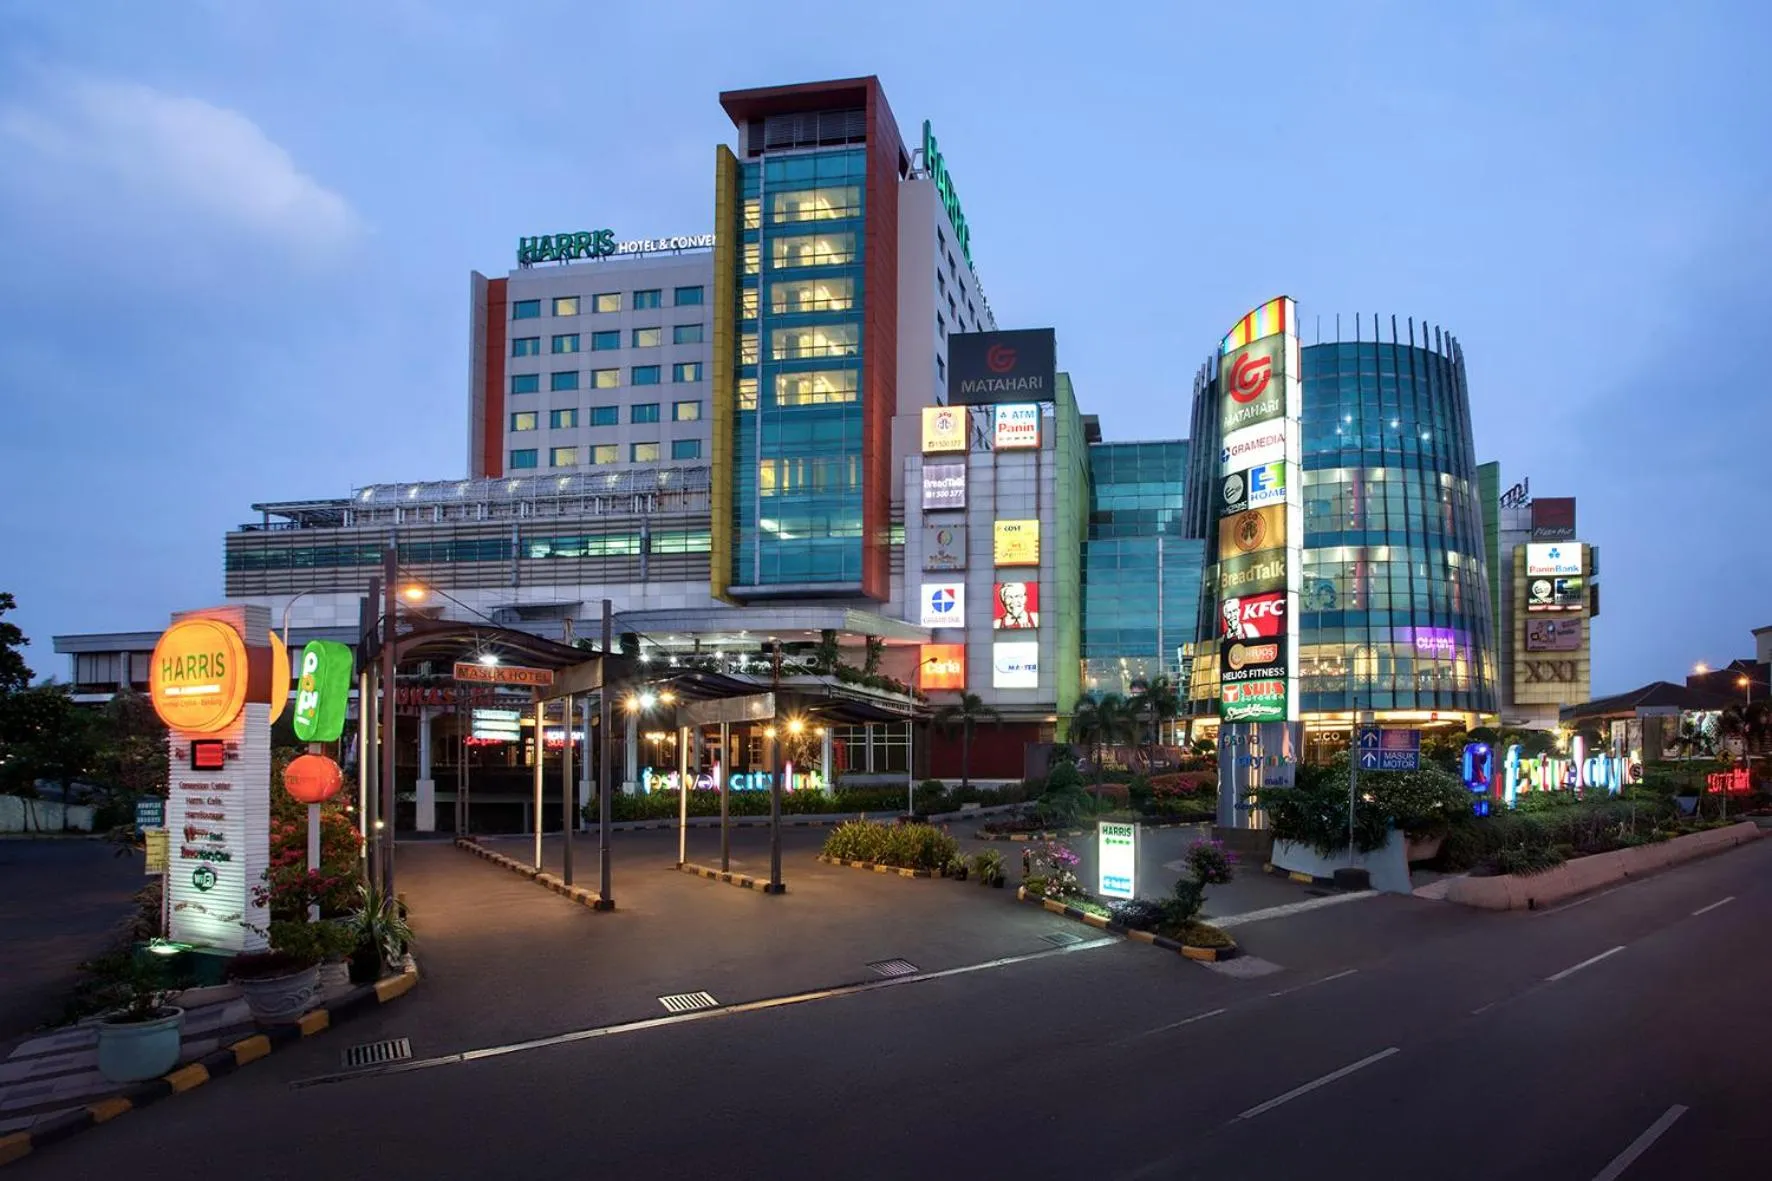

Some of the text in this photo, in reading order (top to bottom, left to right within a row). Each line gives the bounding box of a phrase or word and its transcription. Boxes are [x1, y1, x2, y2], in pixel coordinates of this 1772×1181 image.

[519, 229, 616, 263] HARRIS
[618, 238, 657, 253] HOTEL
[660, 238, 668, 250] &
[961, 376, 1043, 393] MATAHARI
[1012, 411, 1034, 419] ATM
[1224, 400, 1279, 426] MATAHARI
[998, 422, 1034, 432] Panin
[1231, 433, 1285, 457] GRAMEDIA
[1250, 487, 1286, 501] HOME
[1222, 560, 1285, 588] BreadTalk
[1242, 600, 1286, 620] KFC
[162, 652, 225, 682] HARRIS
[458, 668, 549, 681] MASUK HOTEL
[1222, 667, 1285, 680] HELIOS FITNESS
[1524, 661, 1578, 683] XXI
[1242, 681, 1285, 696] SUIS
[1384, 752, 1415, 760] MASUK
[1383, 760, 1415, 769] MOTOR
[1708, 773, 1734, 792] LOTTE
[1102, 826, 1132, 837] HARRIS
